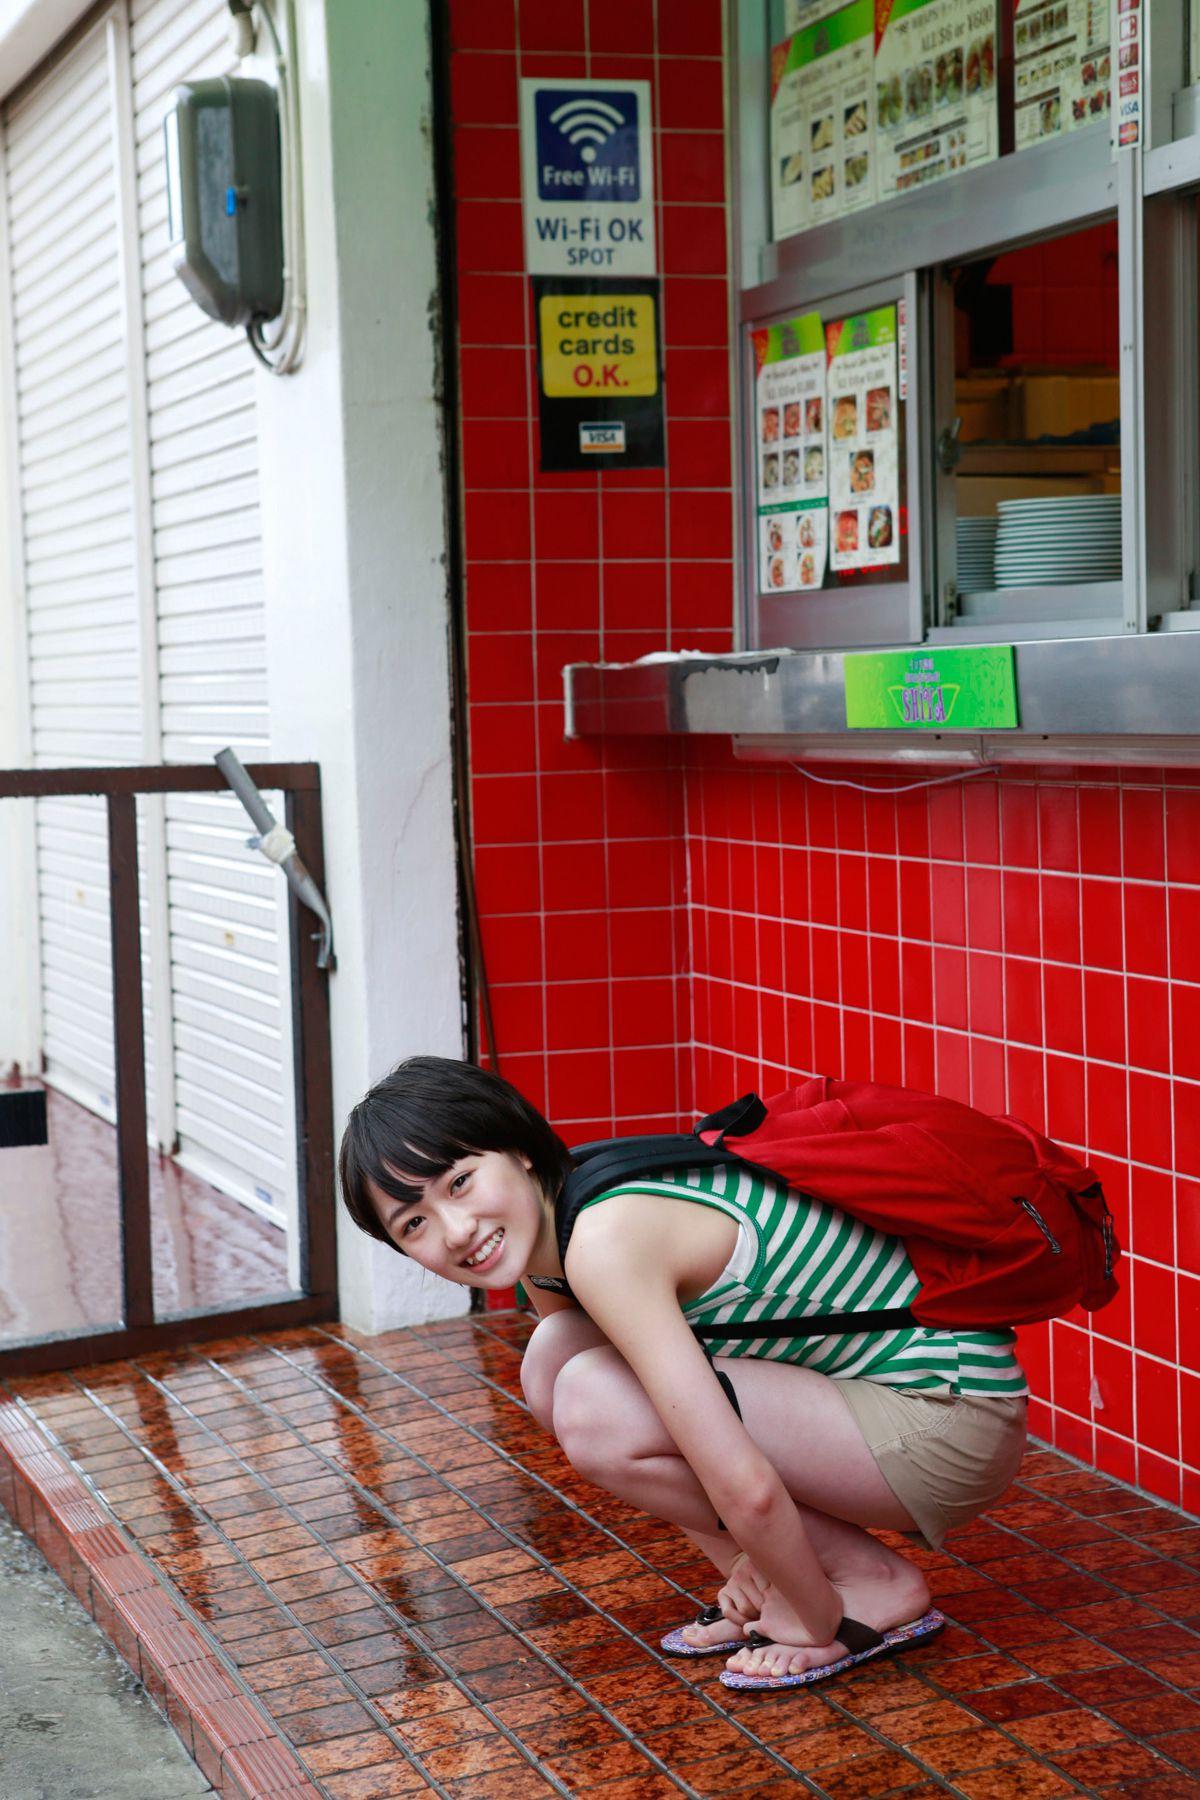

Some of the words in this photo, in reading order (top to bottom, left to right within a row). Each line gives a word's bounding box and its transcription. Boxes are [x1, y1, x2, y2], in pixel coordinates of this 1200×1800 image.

[1120, 101, 1139, 116] VISA
[543, 165, 585, 186] Free
[588, 166, 636, 187] Wi-Fi
[536, 217, 600, 242] Wi-Fi
[608, 218, 644, 242] OK
[567, 247, 615, 266] SPOT
[558, 306, 637, 328] credit
[559, 335, 635, 356] cards
[573, 364, 629, 388] O.K.
[589, 431, 616, 444] VISA
